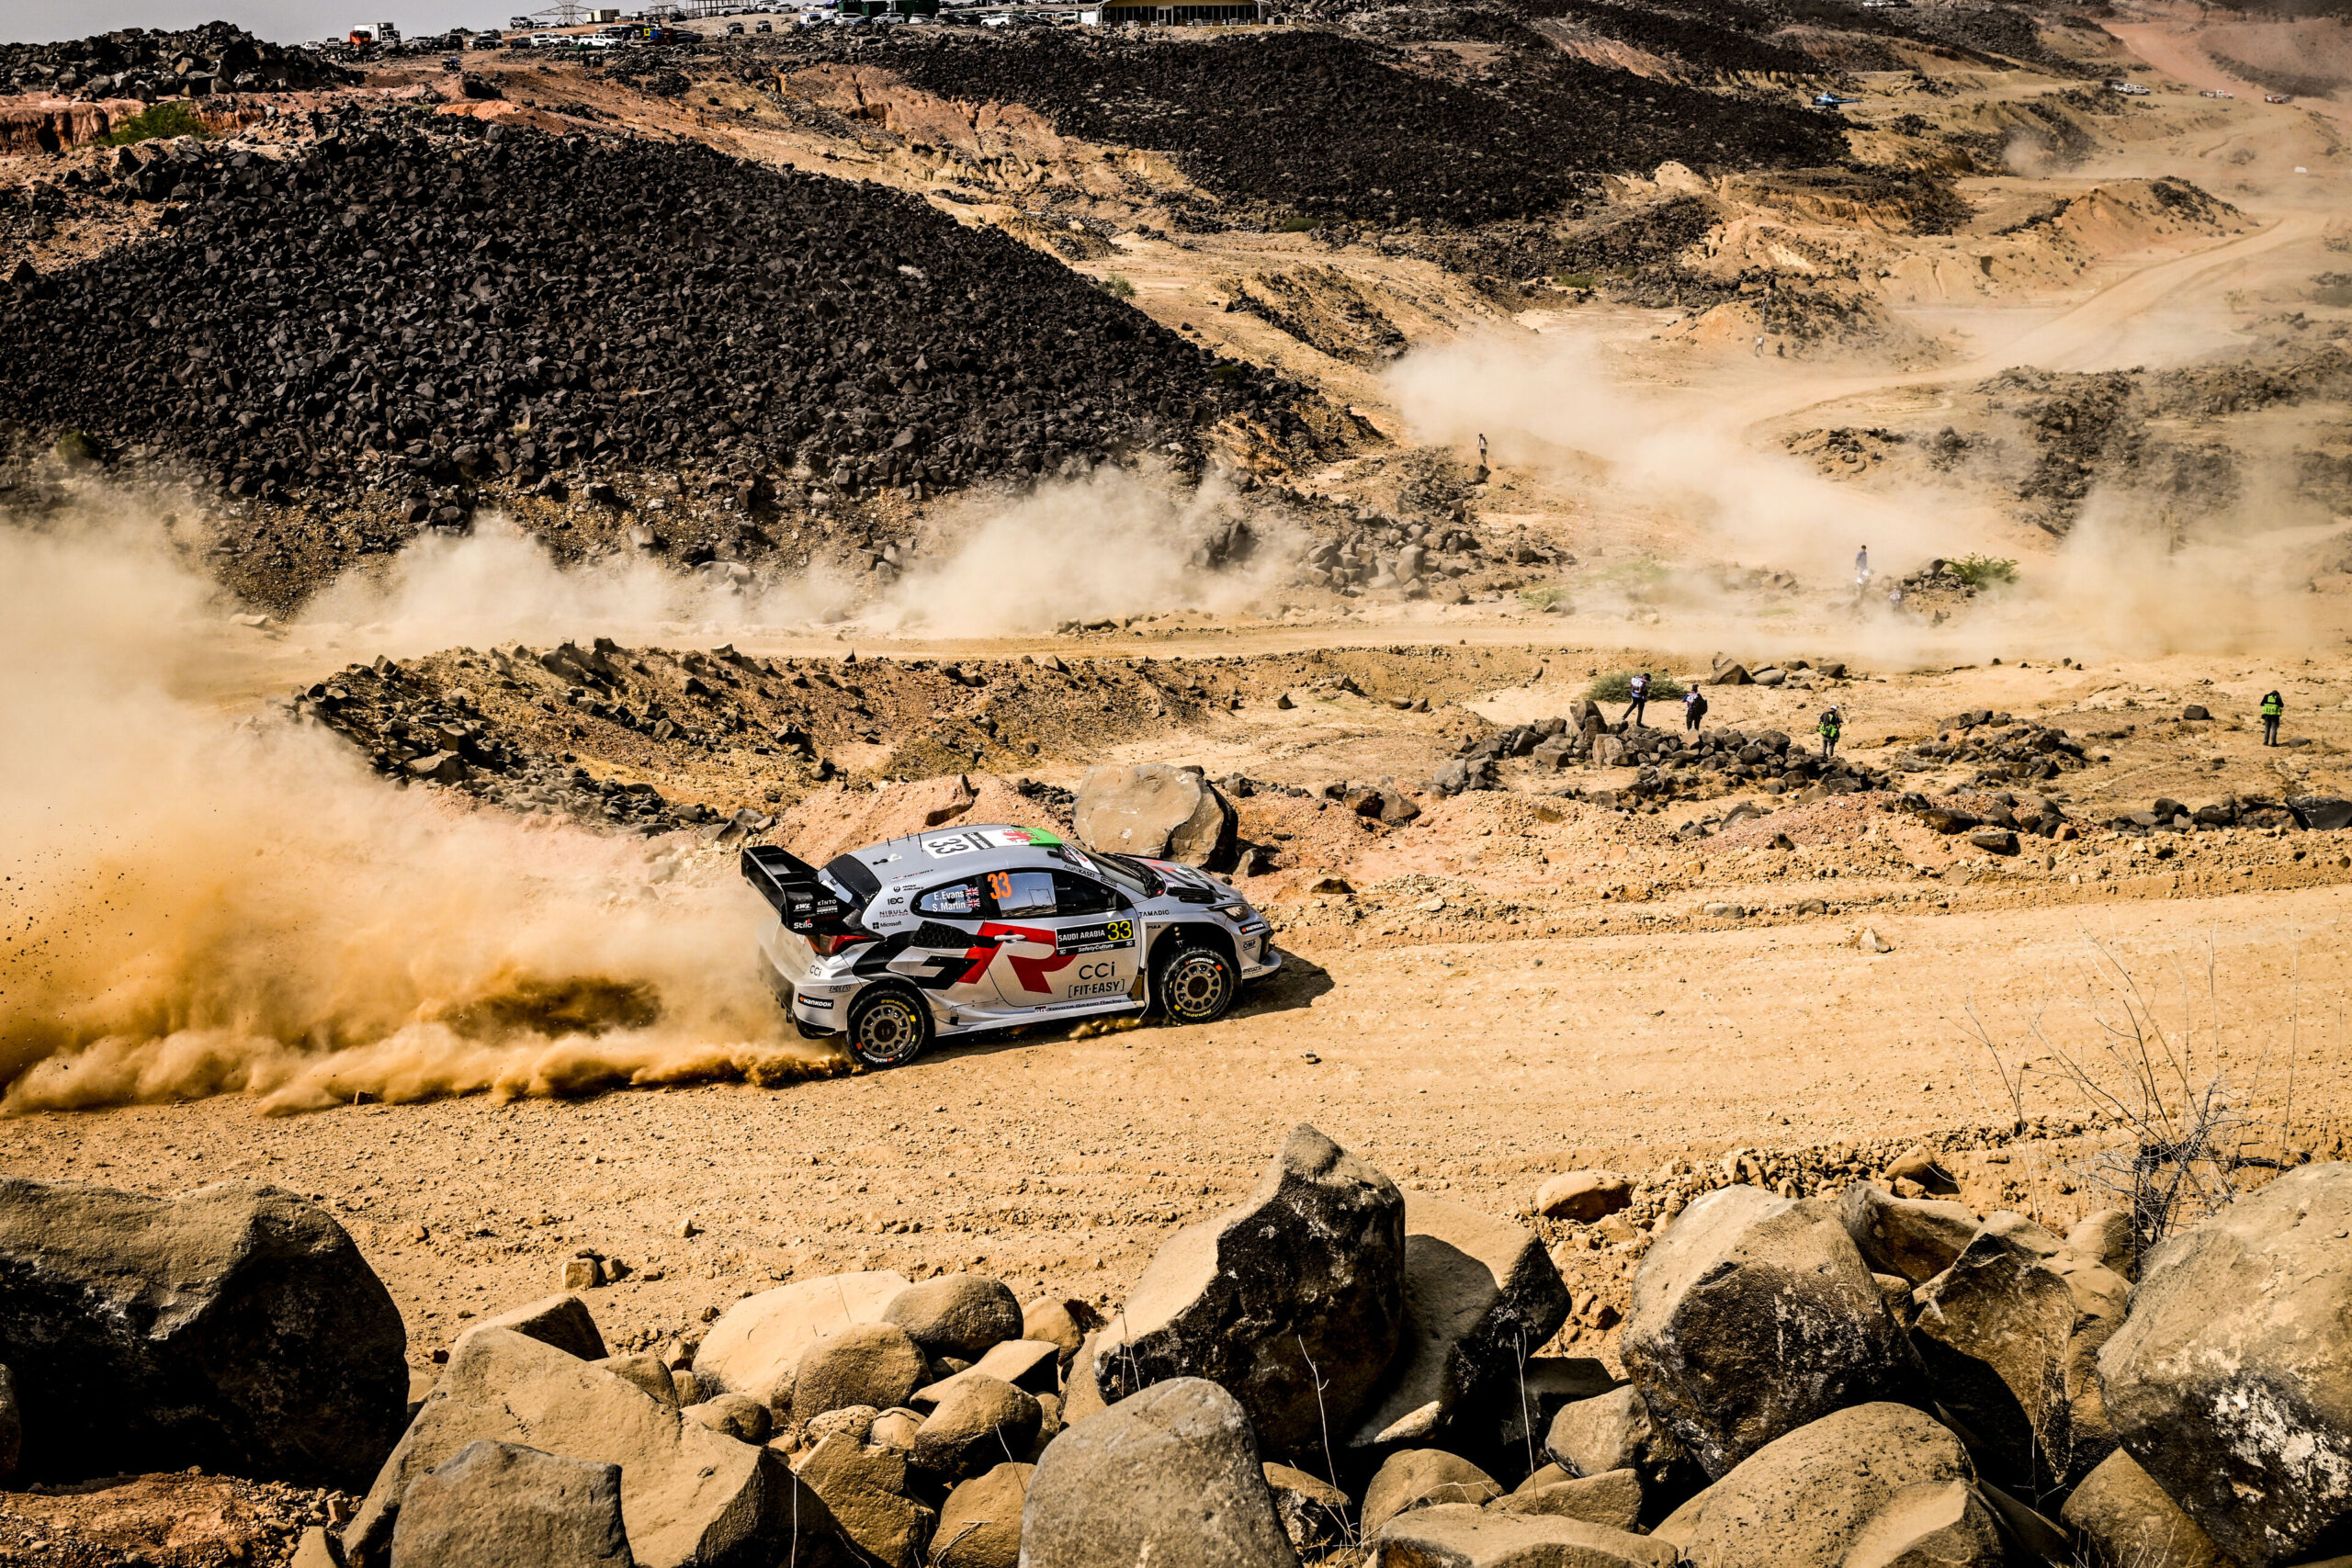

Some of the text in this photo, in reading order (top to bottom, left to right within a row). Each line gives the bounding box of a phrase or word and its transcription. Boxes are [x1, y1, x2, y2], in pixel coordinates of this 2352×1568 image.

[987, 871, 1012, 900] 33
[933, 891, 964, 901] E.Evans
[932, 901, 966, 912] S.Martin
[794, 919, 813, 929] Stilo
[1057, 920, 1133, 942] SAUDI ARABIA 33
[1078, 943, 1114, 953] SafetyCulture
